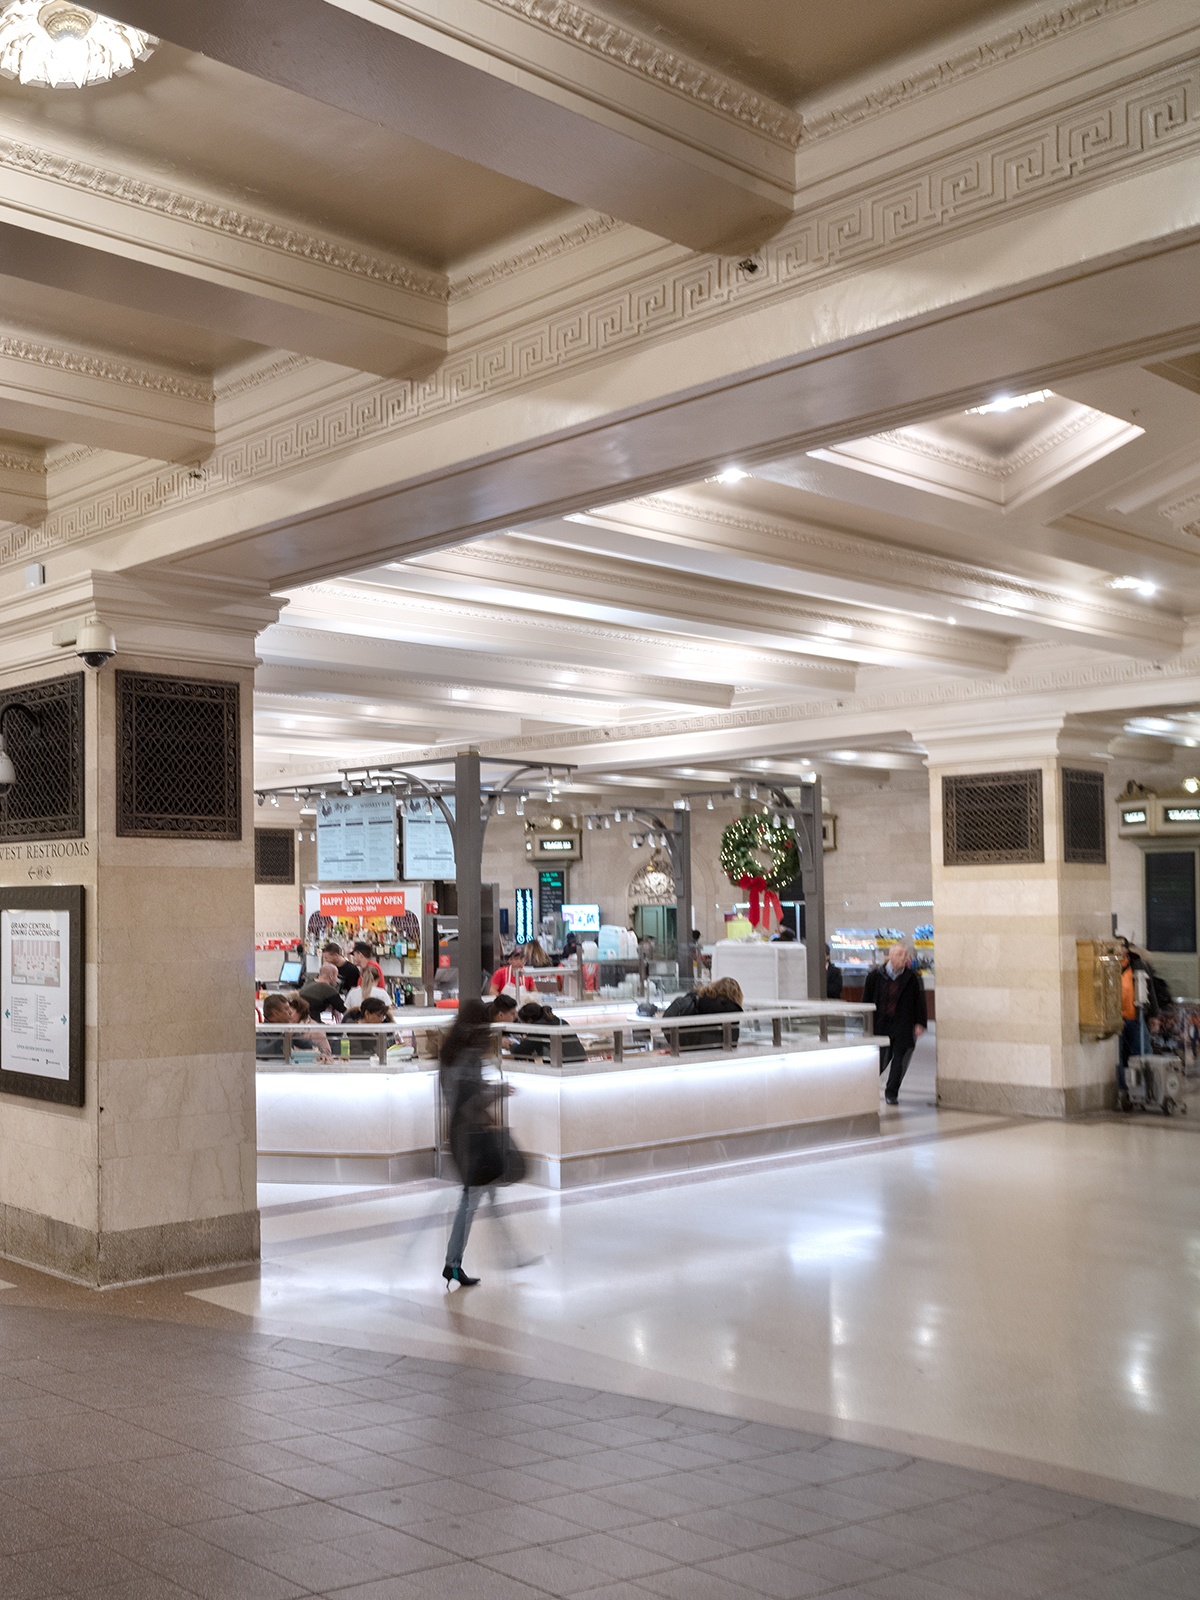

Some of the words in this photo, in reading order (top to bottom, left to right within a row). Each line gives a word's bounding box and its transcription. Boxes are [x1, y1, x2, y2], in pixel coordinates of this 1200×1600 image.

[26, 841, 90, 859] RESTROOMS
[322, 896, 343, 906] HAPPY
[344, 896, 364, 905] HOUR
[365, 895, 382, 905] NOW
[383, 895, 403, 905] OPEN
